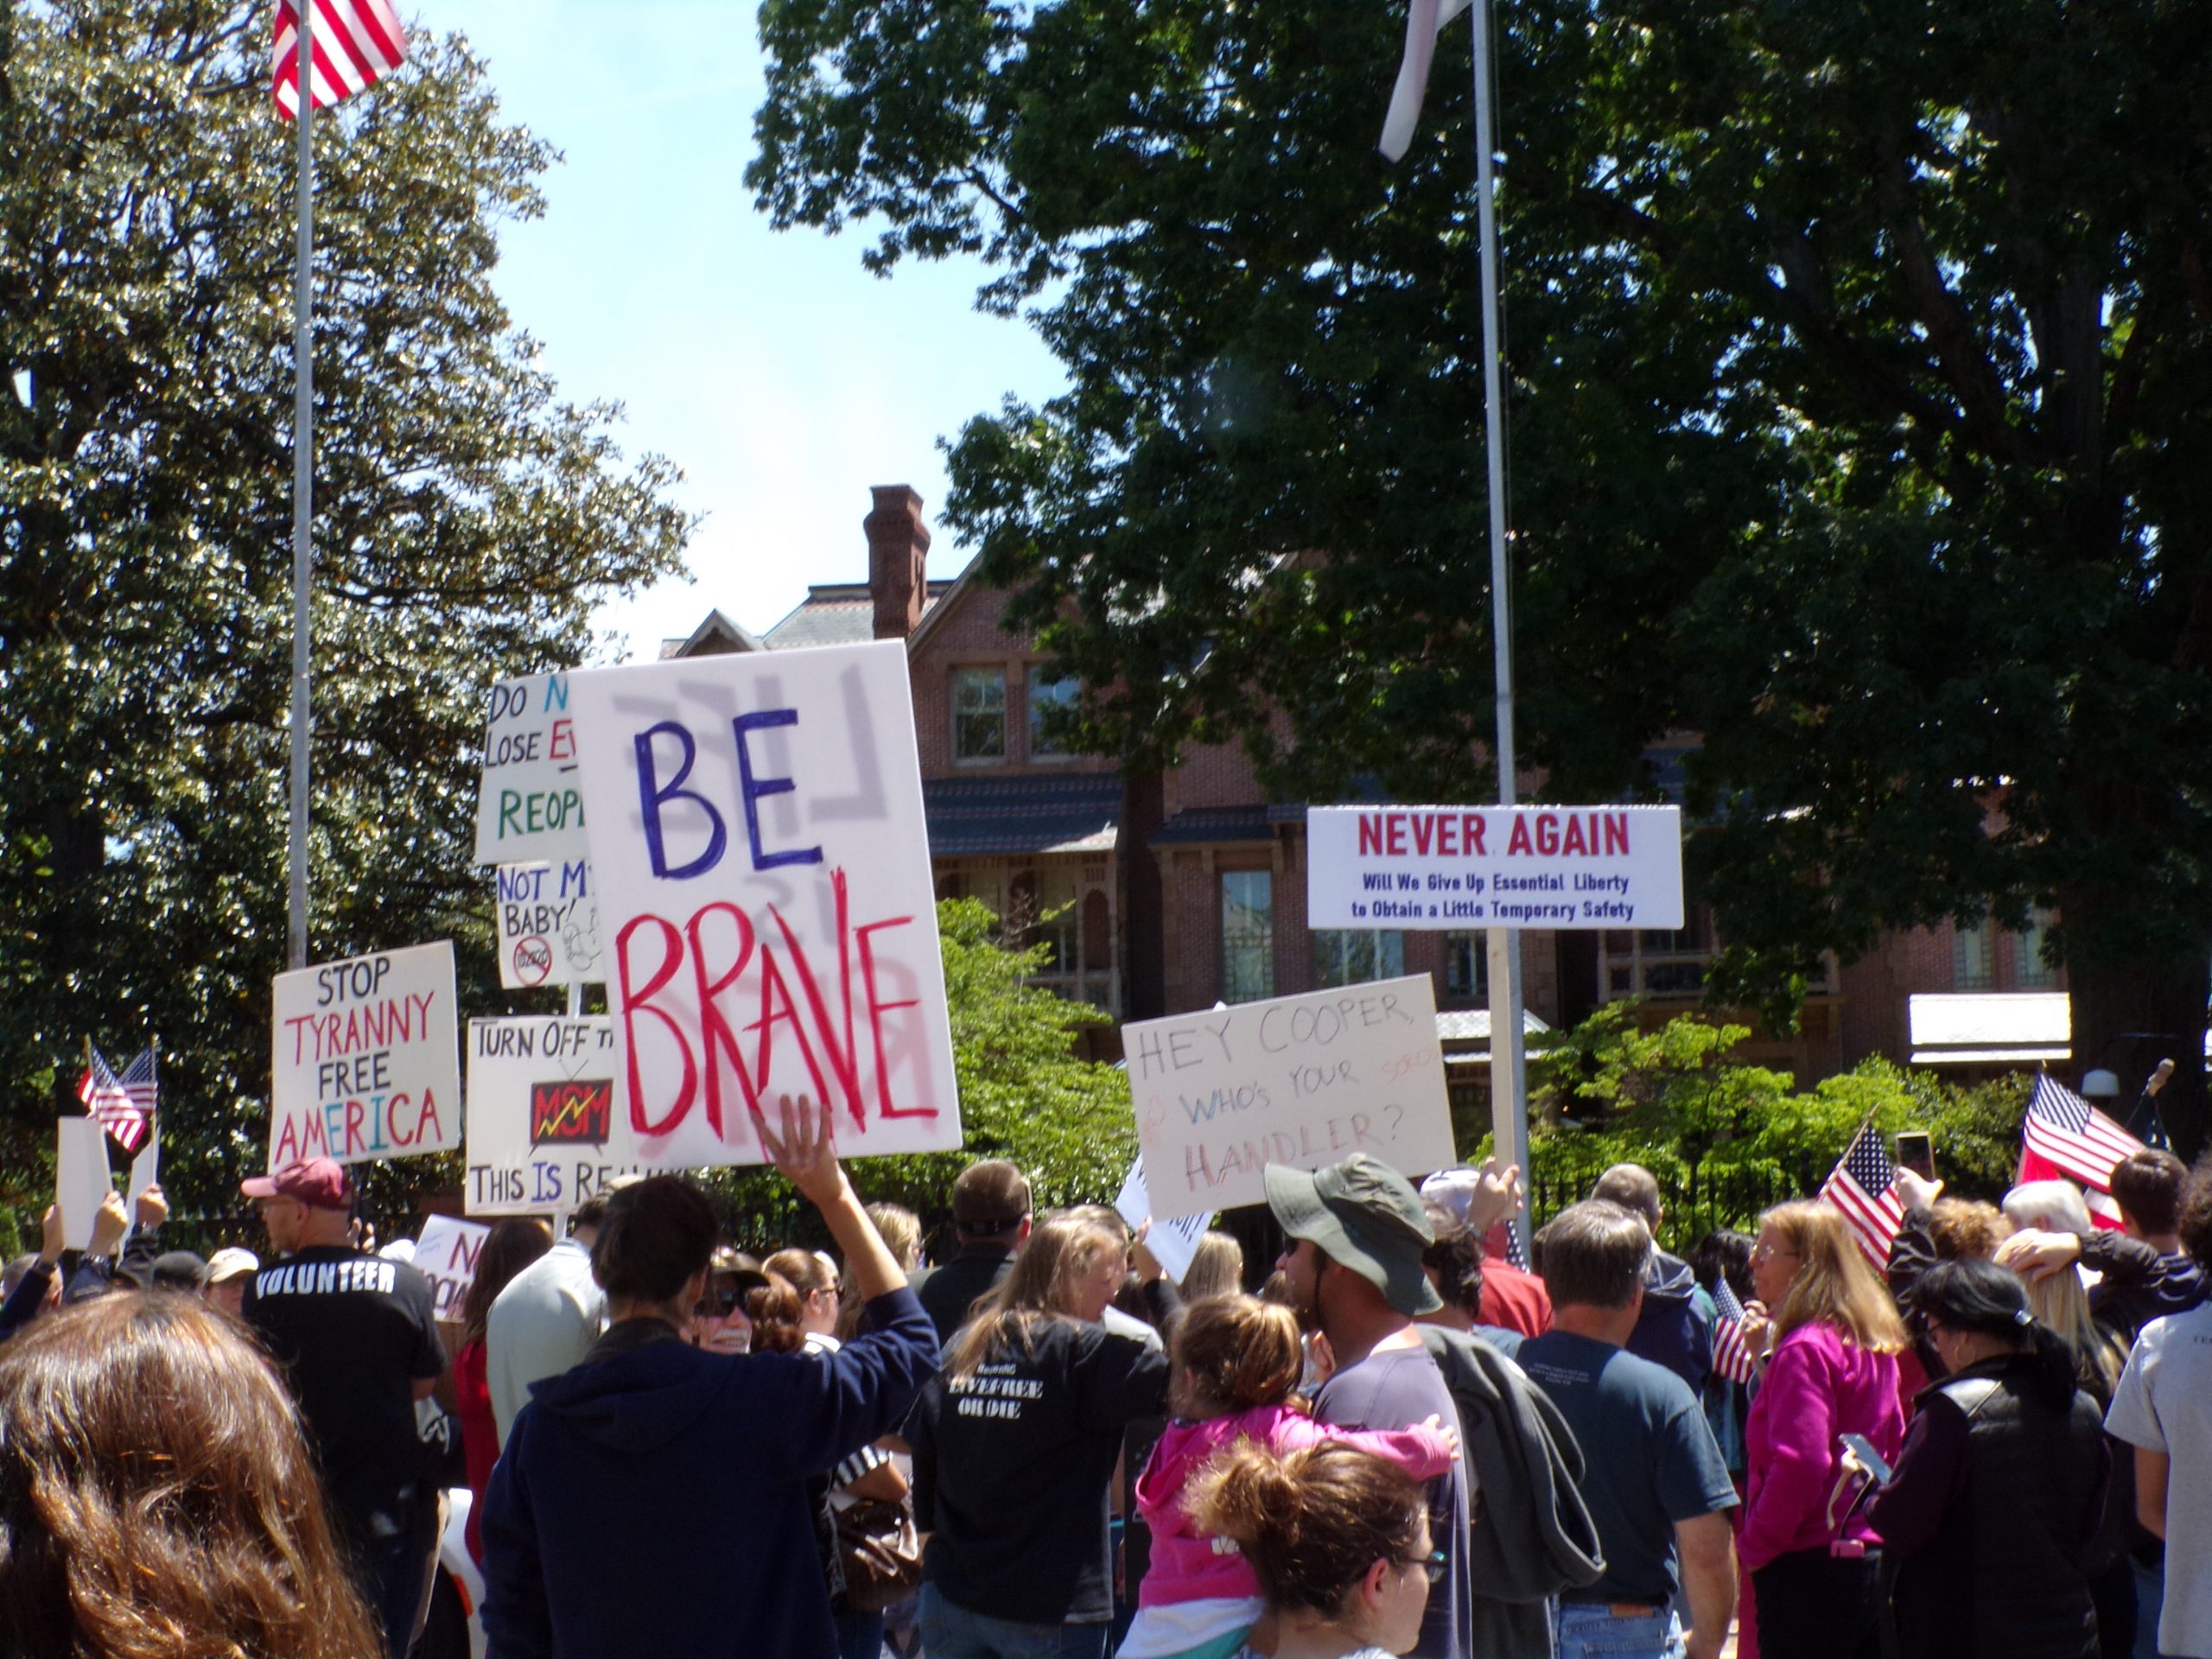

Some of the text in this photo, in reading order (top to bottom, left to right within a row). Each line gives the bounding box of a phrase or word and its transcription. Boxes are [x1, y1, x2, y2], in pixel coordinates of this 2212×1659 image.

[487, 684, 528, 723] DO
[484, 731, 543, 768] LOSE
[633, 709, 823, 880] BE
[1358, 812, 1630, 856] NEVER AGAIN
[498, 867, 550, 903] NOT
[1363, 873, 1630, 894] Will We Give Up Essential Liberty
[505, 898, 576, 938] BABY!
[1351, 900, 1634, 922] to Obtain a Little Temporary Safety
[317, 957, 391, 1007] STOP
[284, 990, 435, 1066] TYRANNY
[616, 865, 939, 1163] BRAVE
[471, 1020, 535, 1058] TURN
[543, 1021, 590, 1057] OFF
[1138, 994, 1414, 1080] HEY COOPER,
[318, 1051, 391, 1100] FREE
[1288, 1059, 1360, 1098] YOUR
[275, 1086, 443, 1164] AMERICA
[532, 1083, 610, 1140] MSM
[470, 1166, 524, 1204] THIS
[531, 1162, 563, 1202] IS
[256, 1261, 397, 1300] VOLUNTEER
